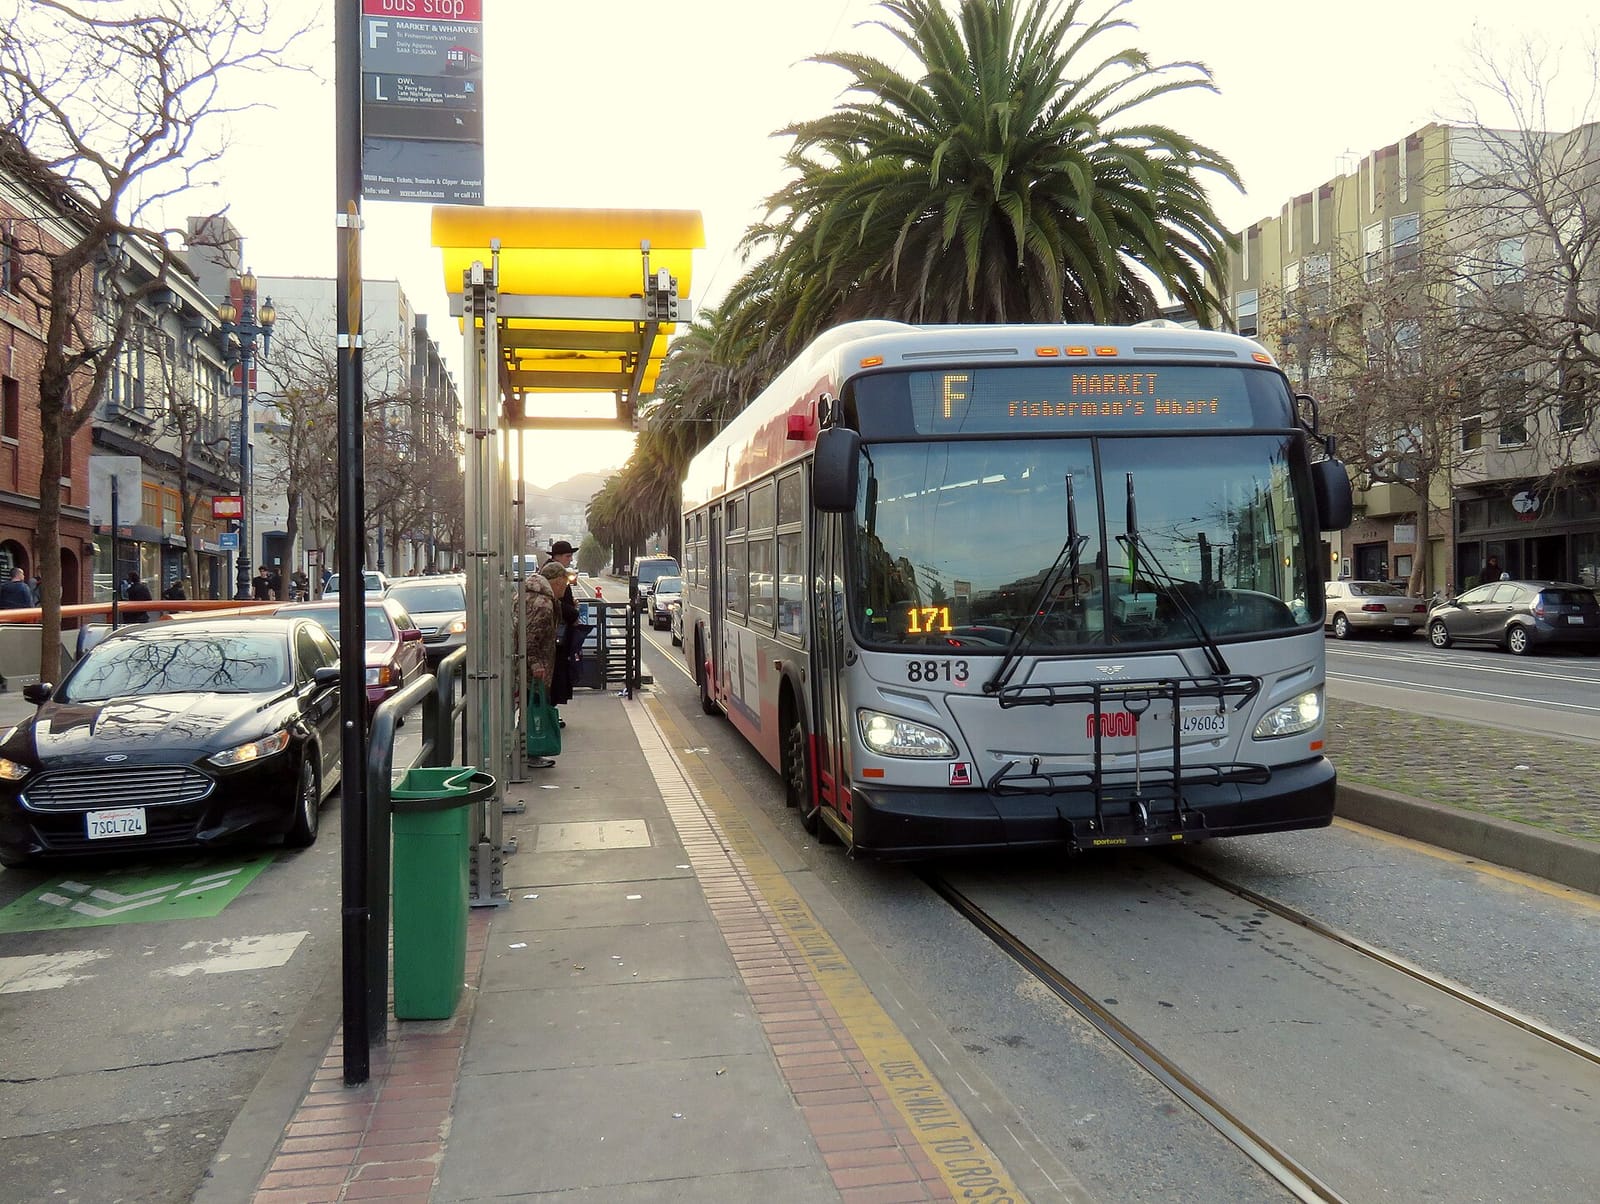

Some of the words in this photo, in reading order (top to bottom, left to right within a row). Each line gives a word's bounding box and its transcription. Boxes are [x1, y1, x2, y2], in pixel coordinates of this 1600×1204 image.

[383, 0, 416, 12] bus
[423, 0, 464, 18] stop
[369, 21, 389, 48] F
[396, 22, 430, 31] MARKET
[431, 24, 438, 32] &
[438, 25, 479, 34] WHARVES
[376, 76, 388, 101] L
[442, 178, 458, 187] Clipper
[461, 179, 482, 187] Accepted
[460, 191, 471, 199] call
[1072, 373, 1157, 395] MARKET
[943, 375, 968, 418] F
[1007, 399, 1145, 417] Fisherman's
[1155, 397, 1220, 415] Wharf
[907, 607, 953, 633] 171
[907, 660, 969, 683] 8813
[1180, 715, 1225, 732] 496063
[91, 818, 142, 834] 7SCL724
[879, 1060, 924, 1081] USE
[928, 1135, 975, 1154] TO
